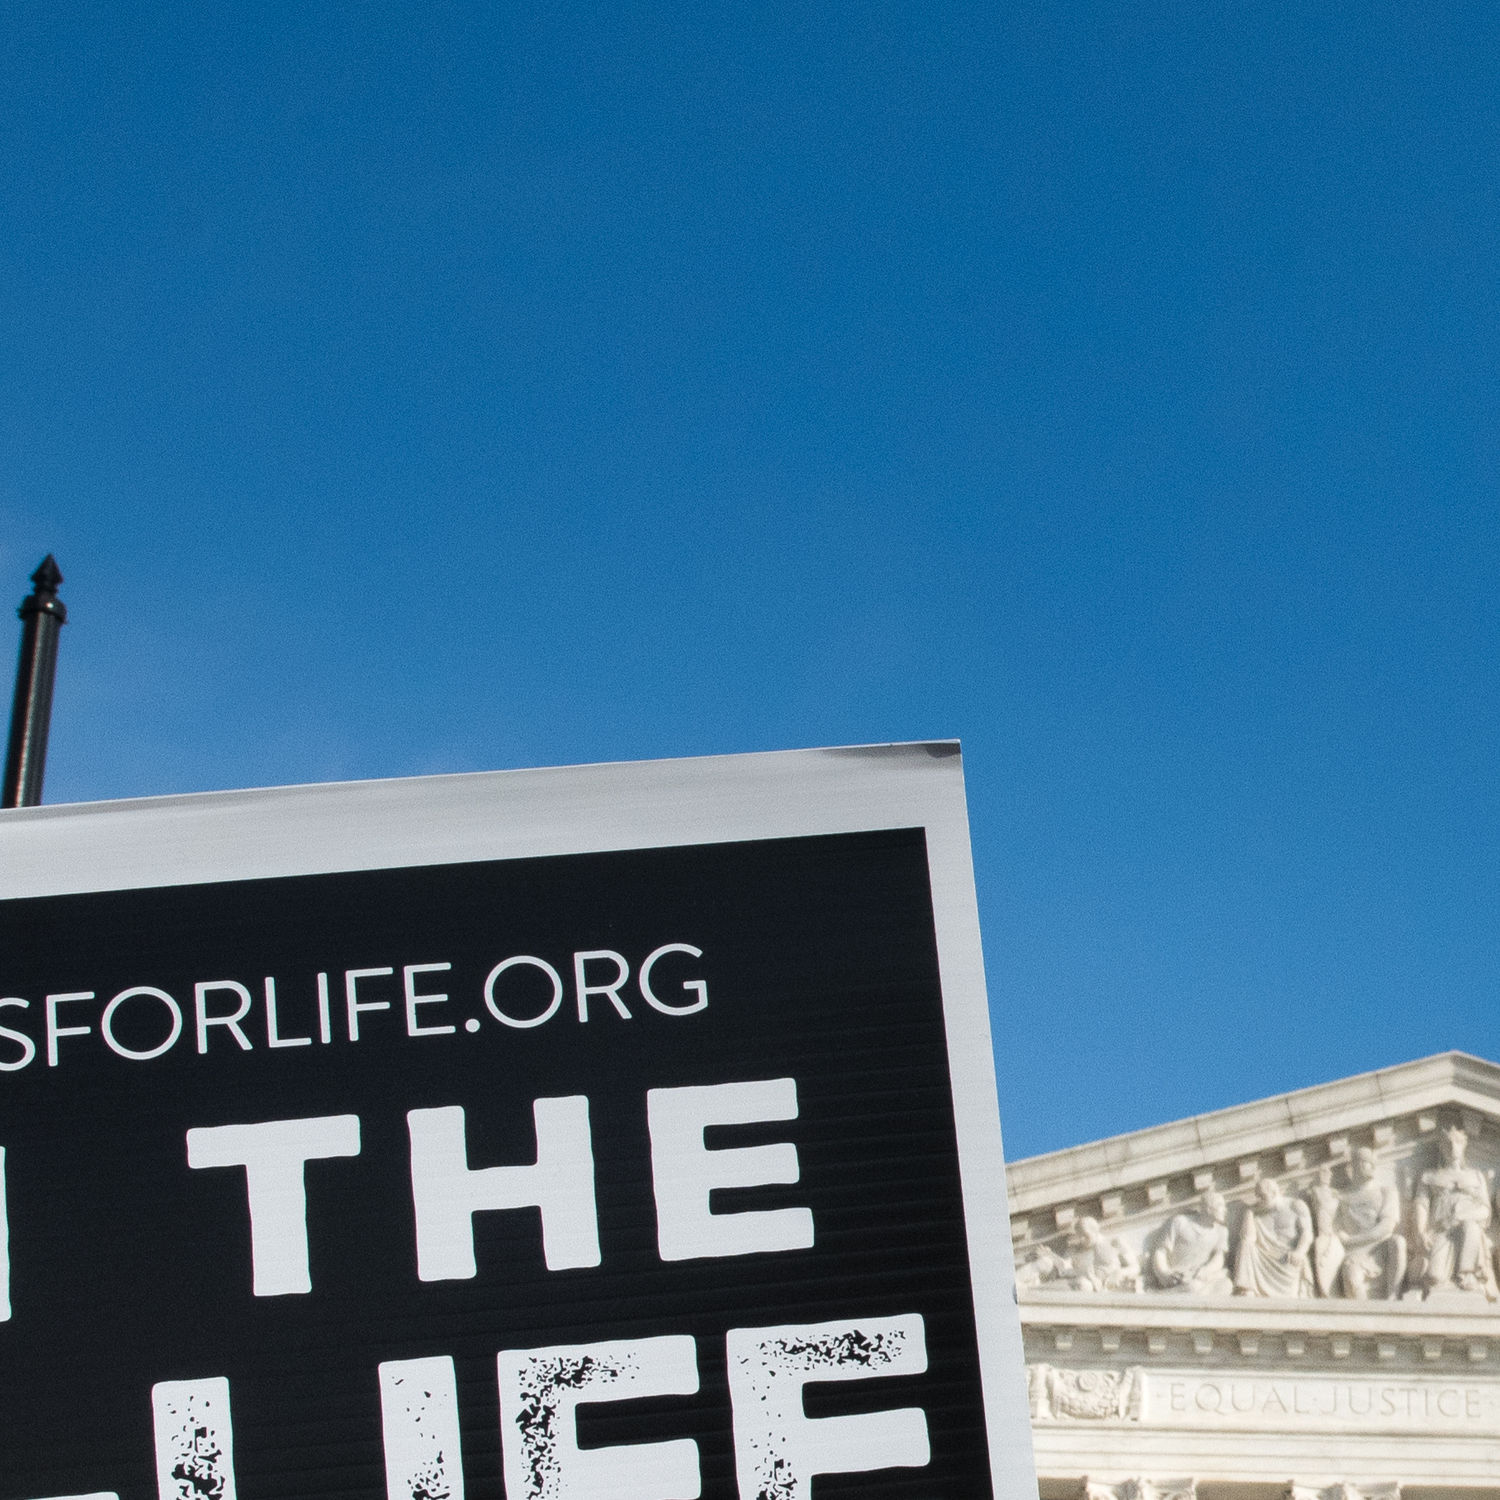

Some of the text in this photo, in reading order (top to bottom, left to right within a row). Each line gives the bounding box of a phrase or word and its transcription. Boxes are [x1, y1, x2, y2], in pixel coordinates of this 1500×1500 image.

[186, 1078, 814, 1296] THE
[1169, 1382, 1311, 1415] EQUAL
[1326, 1384, 1481, 1418] JUSTICE
